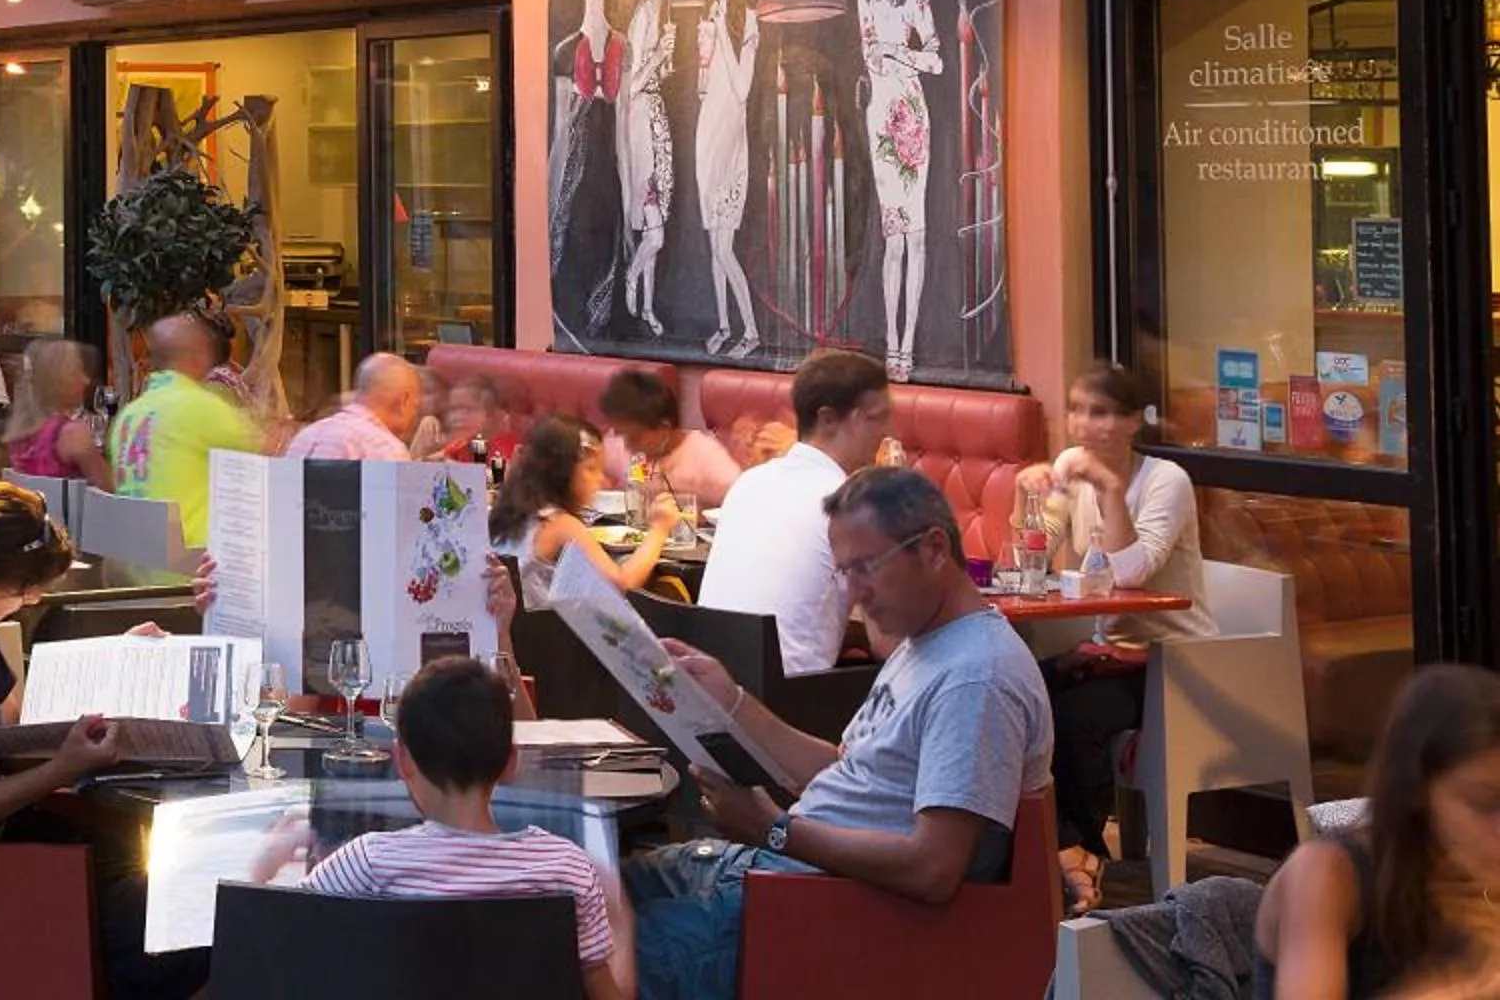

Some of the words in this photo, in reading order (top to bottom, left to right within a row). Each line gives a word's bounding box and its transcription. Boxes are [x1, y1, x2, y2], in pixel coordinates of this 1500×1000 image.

[1224, 23, 1294, 51] Salle
[1162, 121, 1203, 147] Air
[1208, 116, 1367, 146] conditioned
